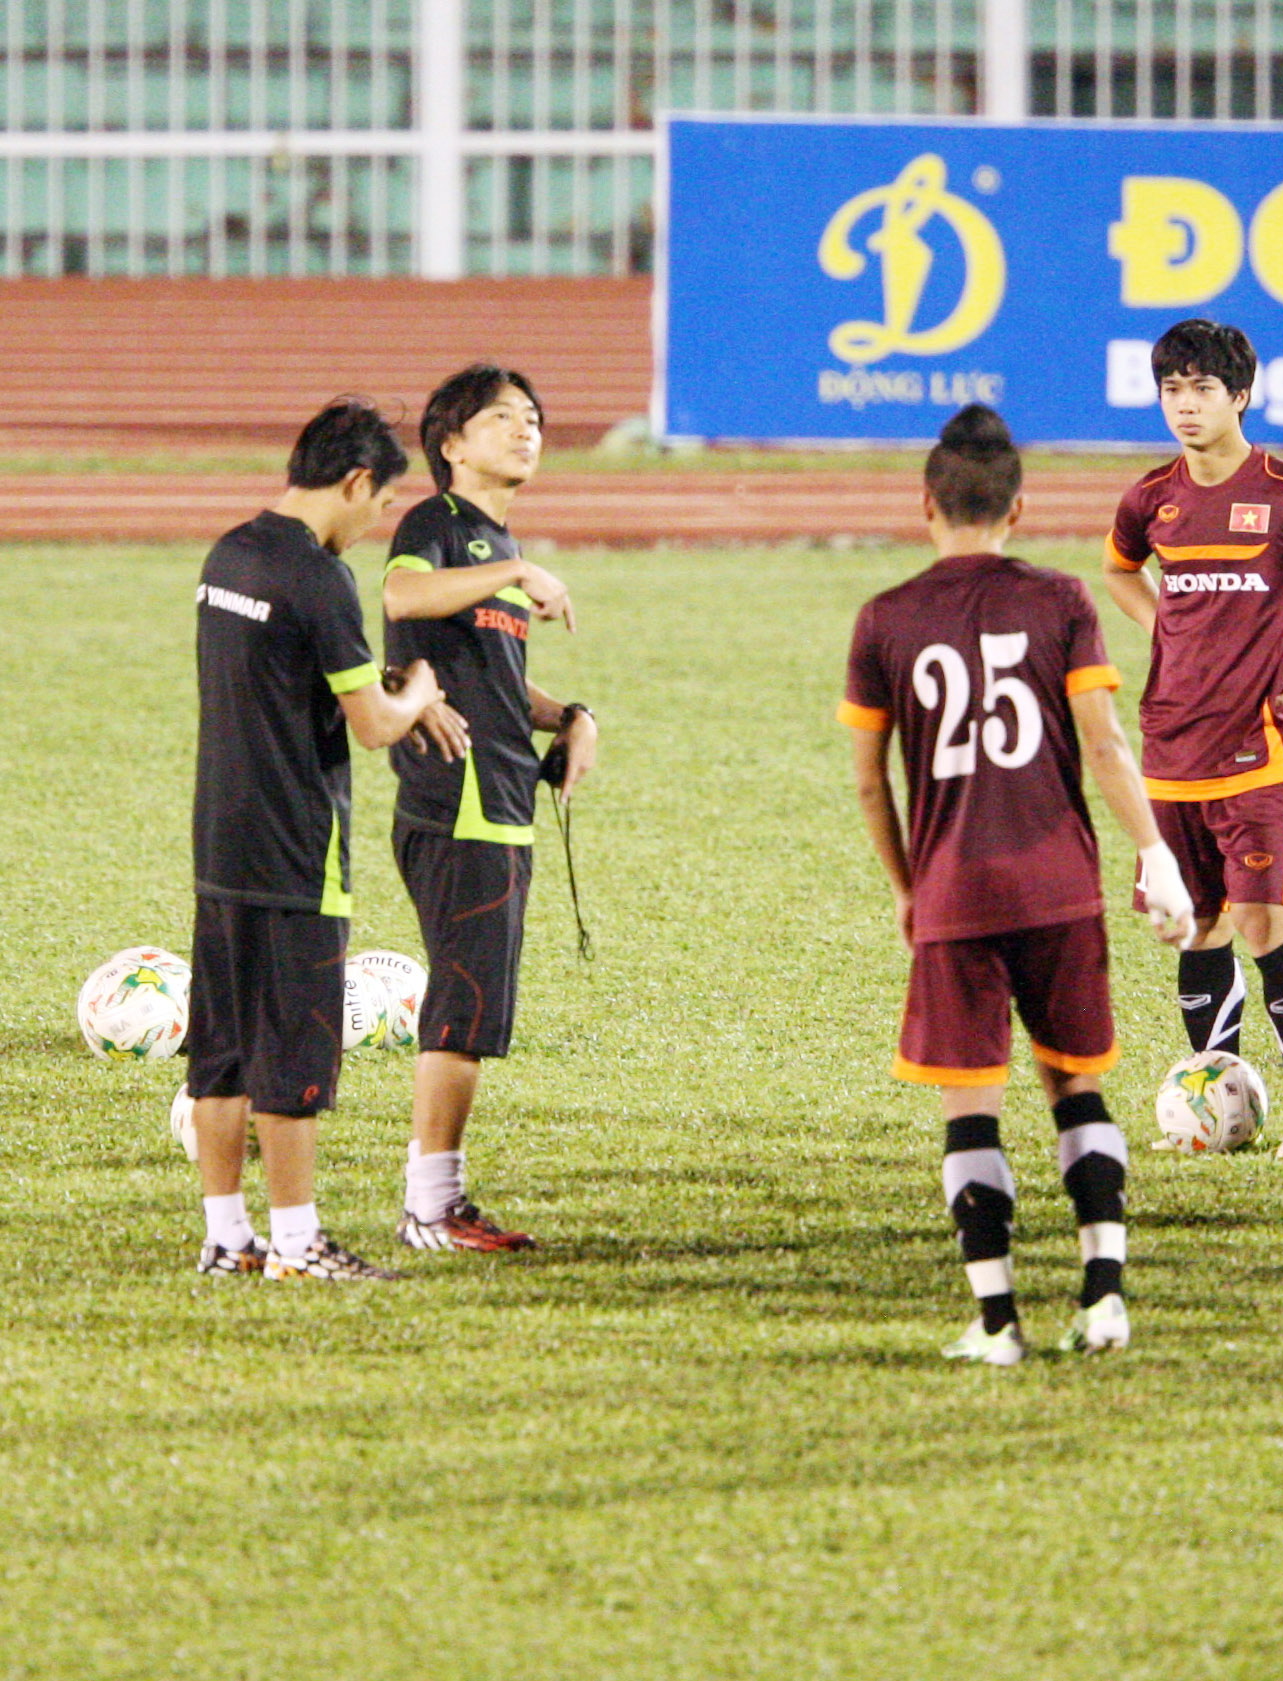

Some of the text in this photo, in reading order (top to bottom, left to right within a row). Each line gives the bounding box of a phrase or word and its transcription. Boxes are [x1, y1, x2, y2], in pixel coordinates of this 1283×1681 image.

[1164, 573, 1270, 592] HONDA
[912, 631, 1043, 780] 25
[362, 956, 412, 974] mitre
[345, 980, 363, 1031] mitre
